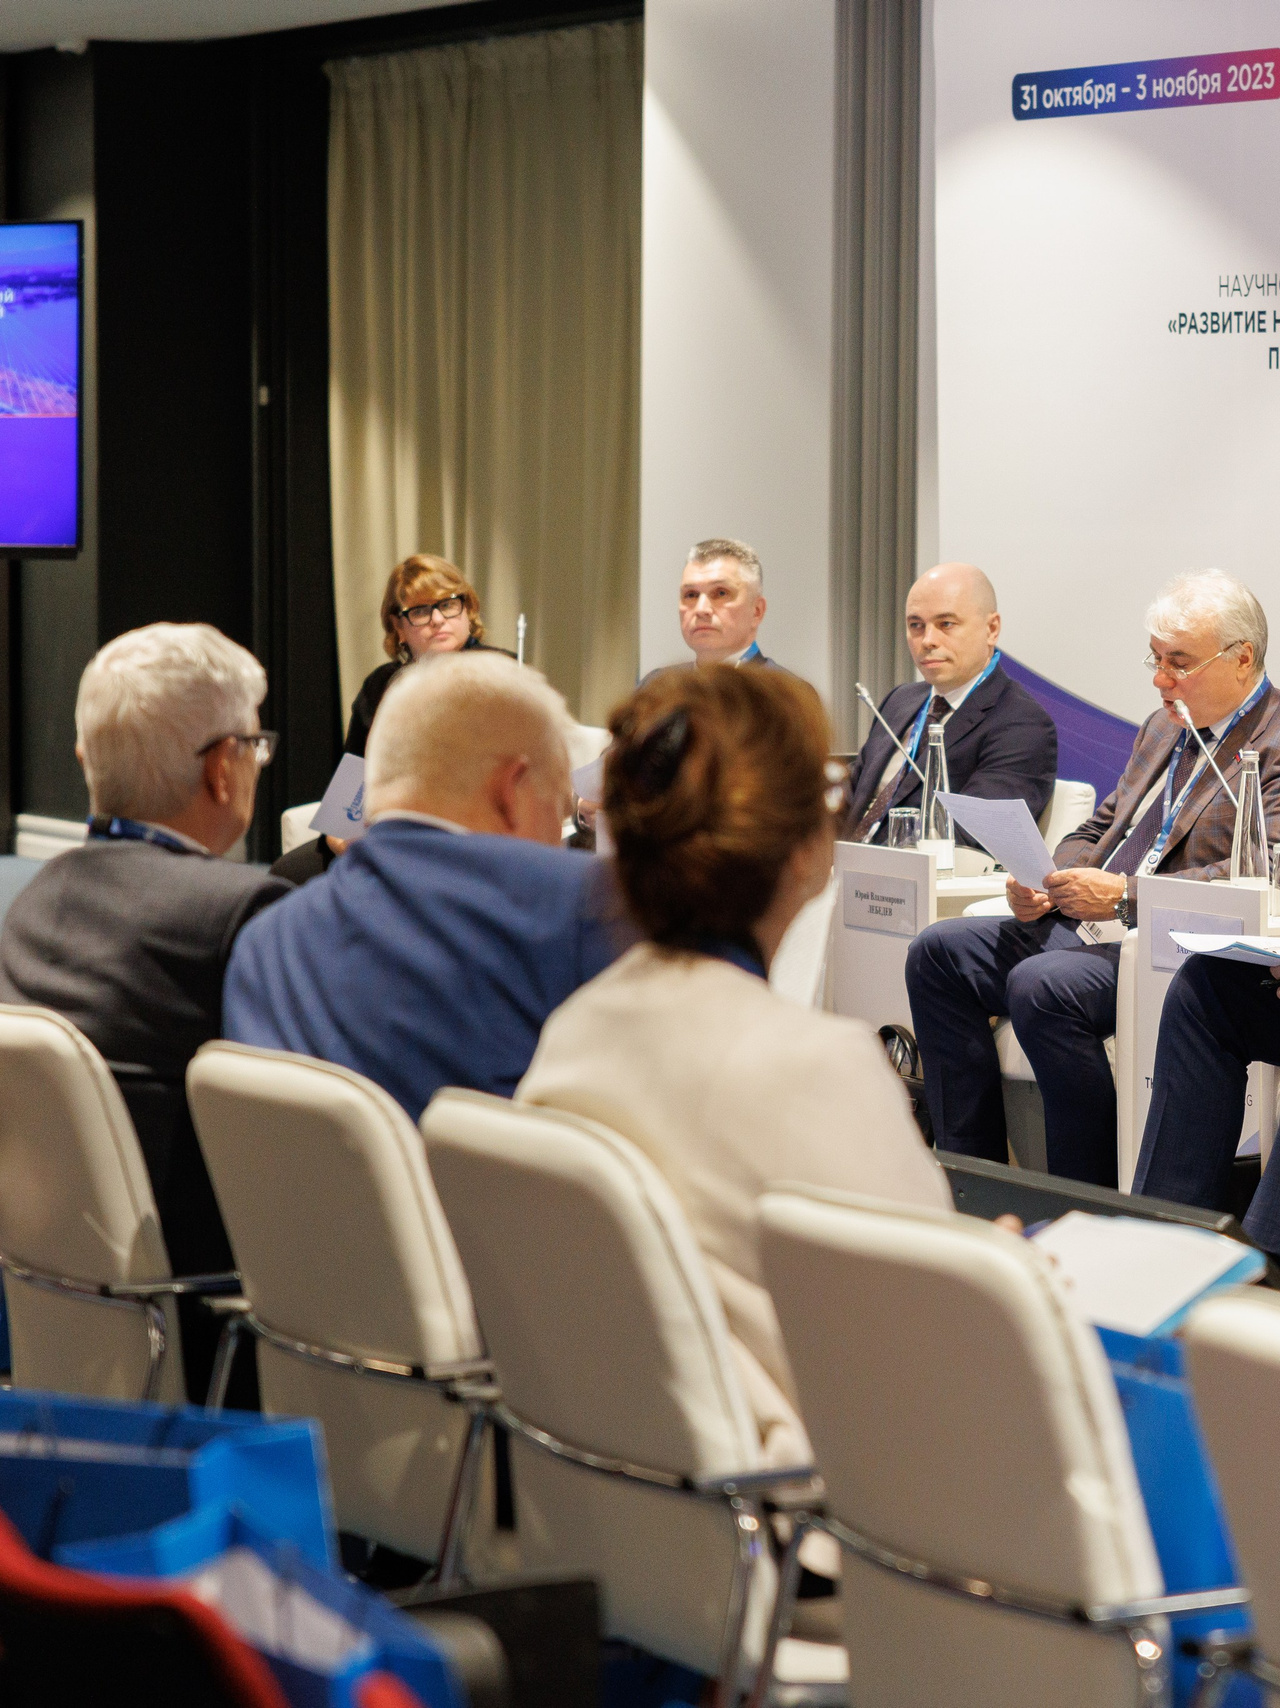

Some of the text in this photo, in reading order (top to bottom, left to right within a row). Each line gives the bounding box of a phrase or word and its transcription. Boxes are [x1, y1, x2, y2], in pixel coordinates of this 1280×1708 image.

[1020, 84, 1038, 111] 31
[1042, 79, 1116, 109] октября
[1136, 75, 1148, 100] 3
[1152, 68, 1221, 97] ноября
[1227, 62, 1275, 92] 2023
[1168, 309, 1267, 336] «РАЗВИТИЕ
